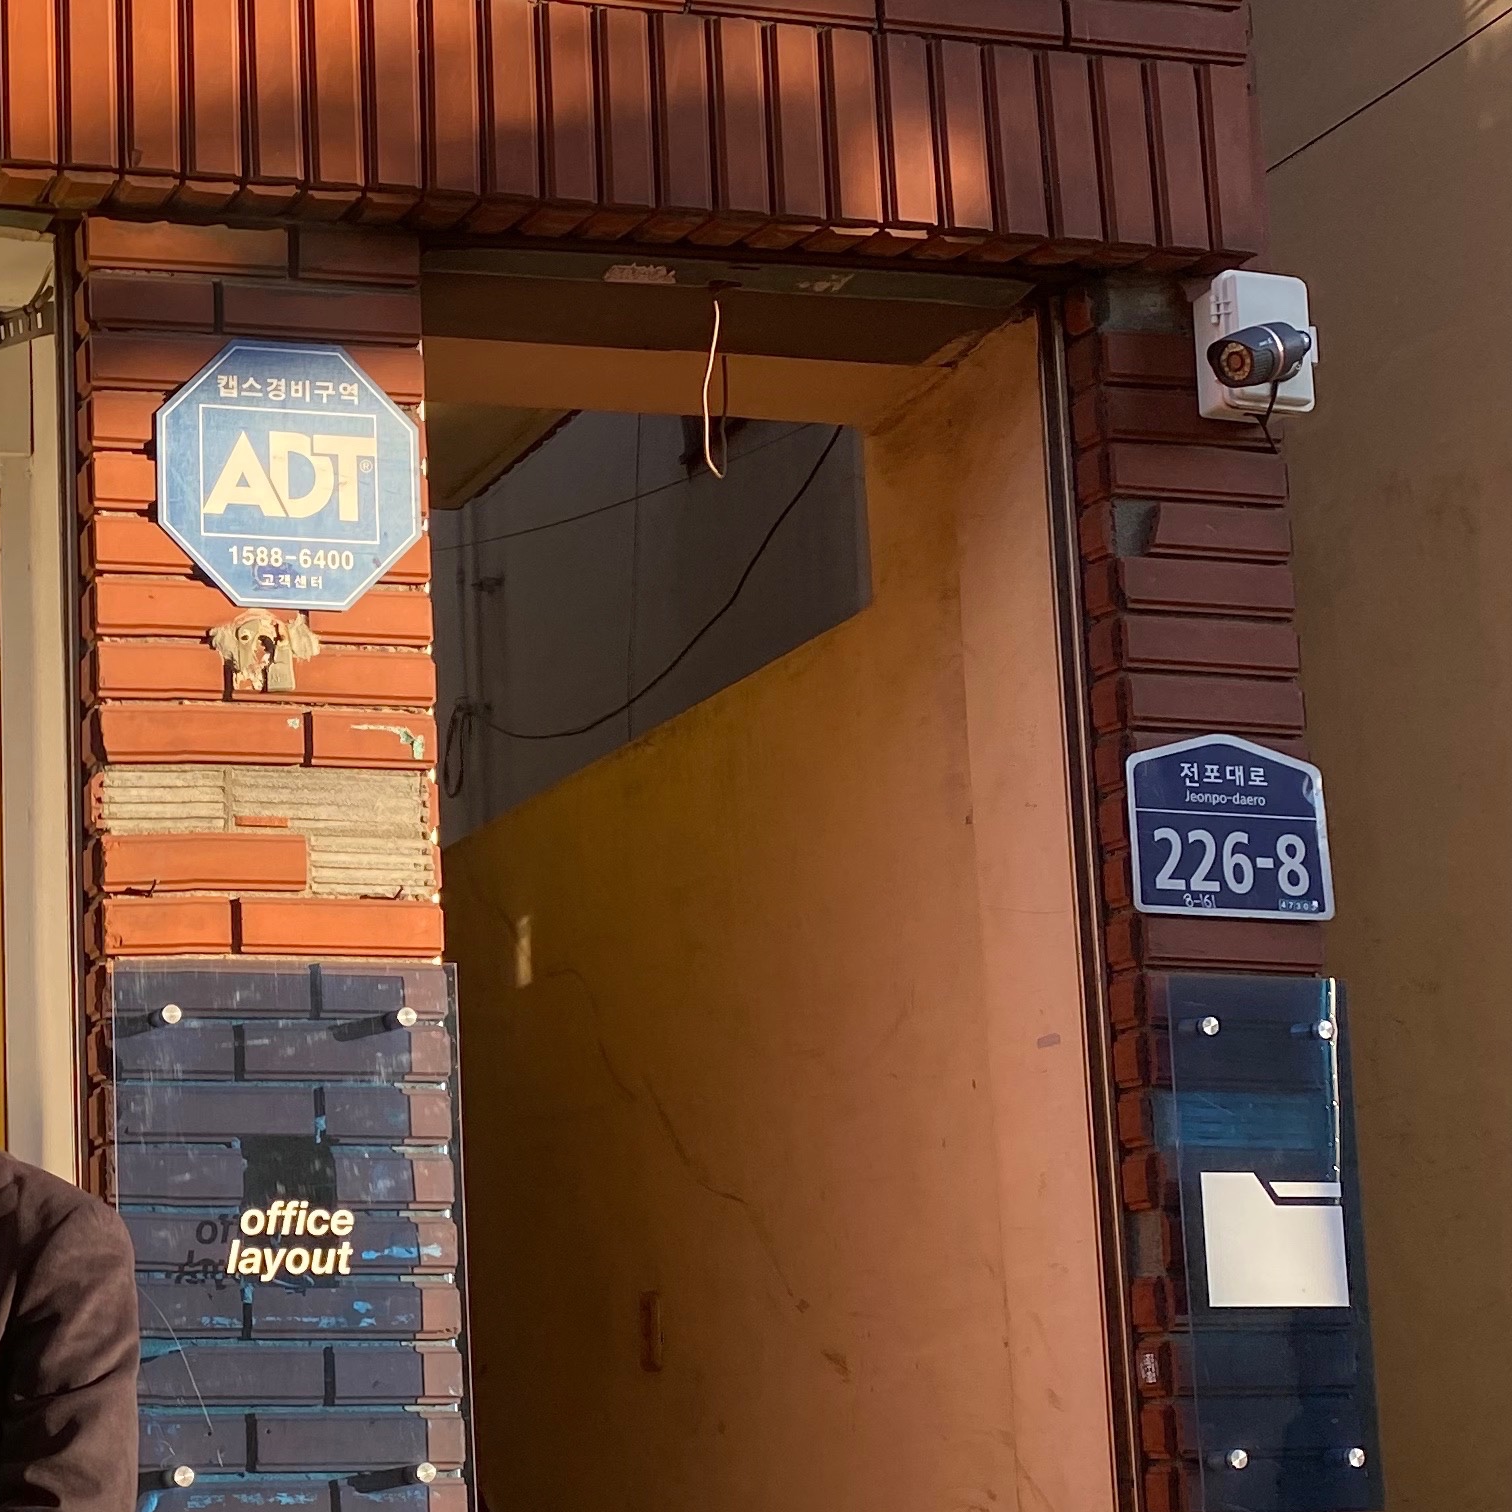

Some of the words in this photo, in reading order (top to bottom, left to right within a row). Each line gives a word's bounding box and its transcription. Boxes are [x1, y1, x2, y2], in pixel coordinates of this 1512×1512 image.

[217, 374, 359, 405] 캡스경비구역
[229, 545, 354, 570] 1588-6400
[262, 573, 323, 590] 고객센터
[1180, 762, 1268, 788] 전포대로
[1185, 789, 1266, 806] Jeonpo-daero
[1153, 827, 1310, 897] 226-8
[240, 1200, 355, 1236] office
[226, 1240, 354, 1282] layout
